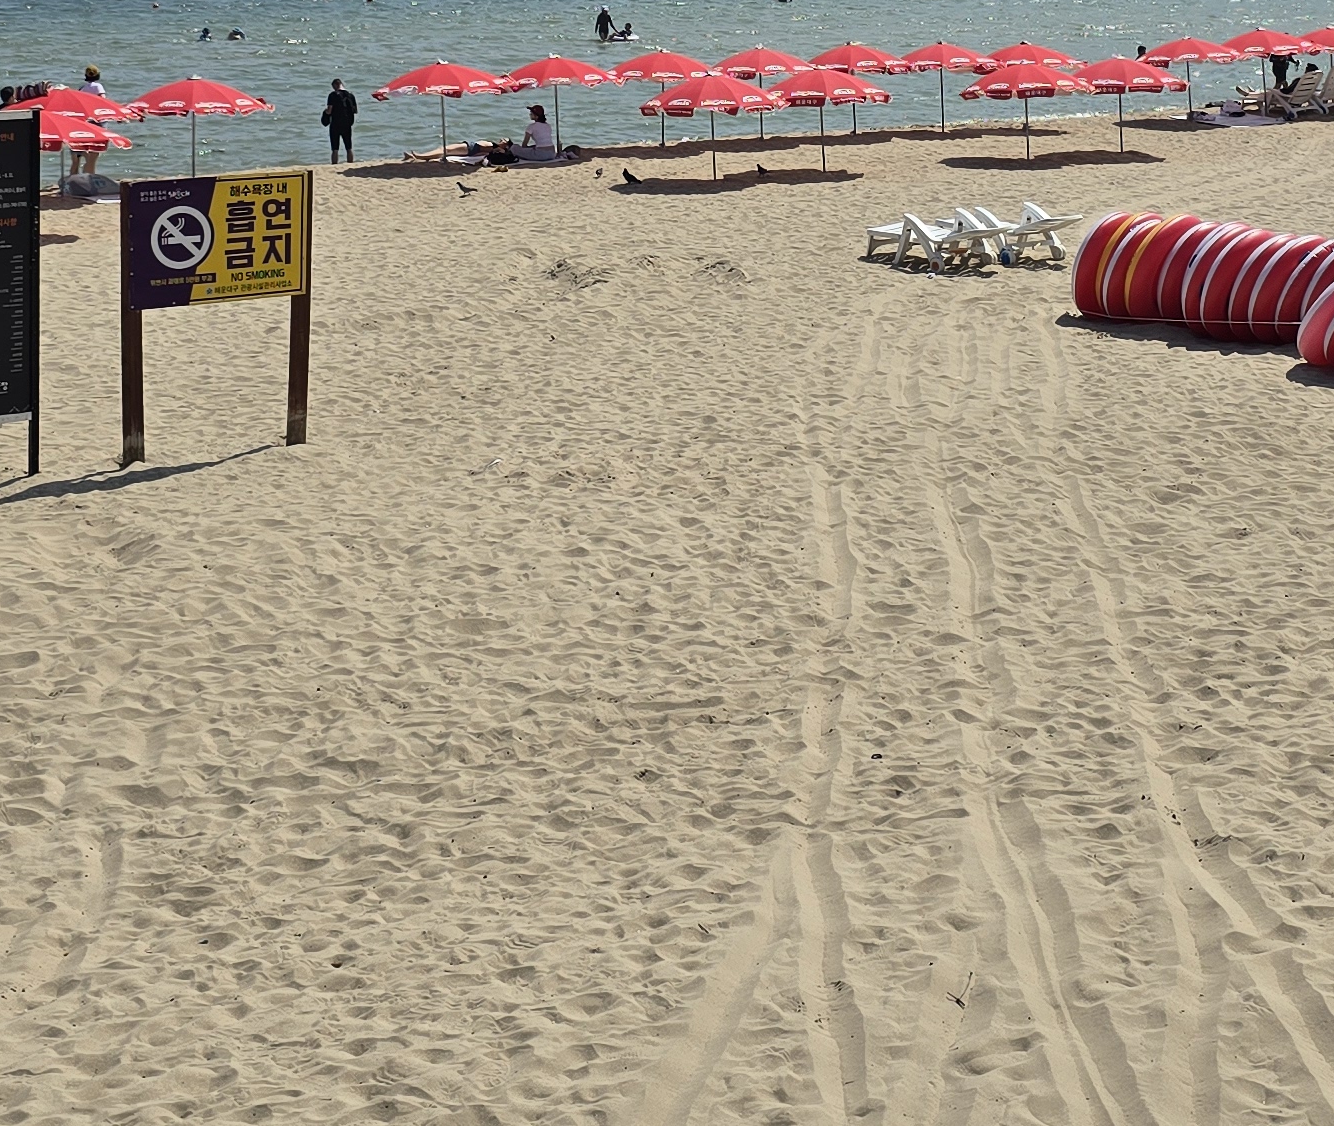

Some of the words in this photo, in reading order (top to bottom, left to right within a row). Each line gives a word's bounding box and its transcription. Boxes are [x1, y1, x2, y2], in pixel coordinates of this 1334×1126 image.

[230, 183, 274, 197] 해수욕장
[276, 182, 287, 194] 내
[225, 198, 291, 234] 흡연
[225, 233, 291, 269] 금지
[231, 272, 244, 282] NO
[246, 268, 285, 281] SMOKING
[214, 284, 239, 294] 해운대구
[240, 280, 292, 292] 관광시설관리사업소
